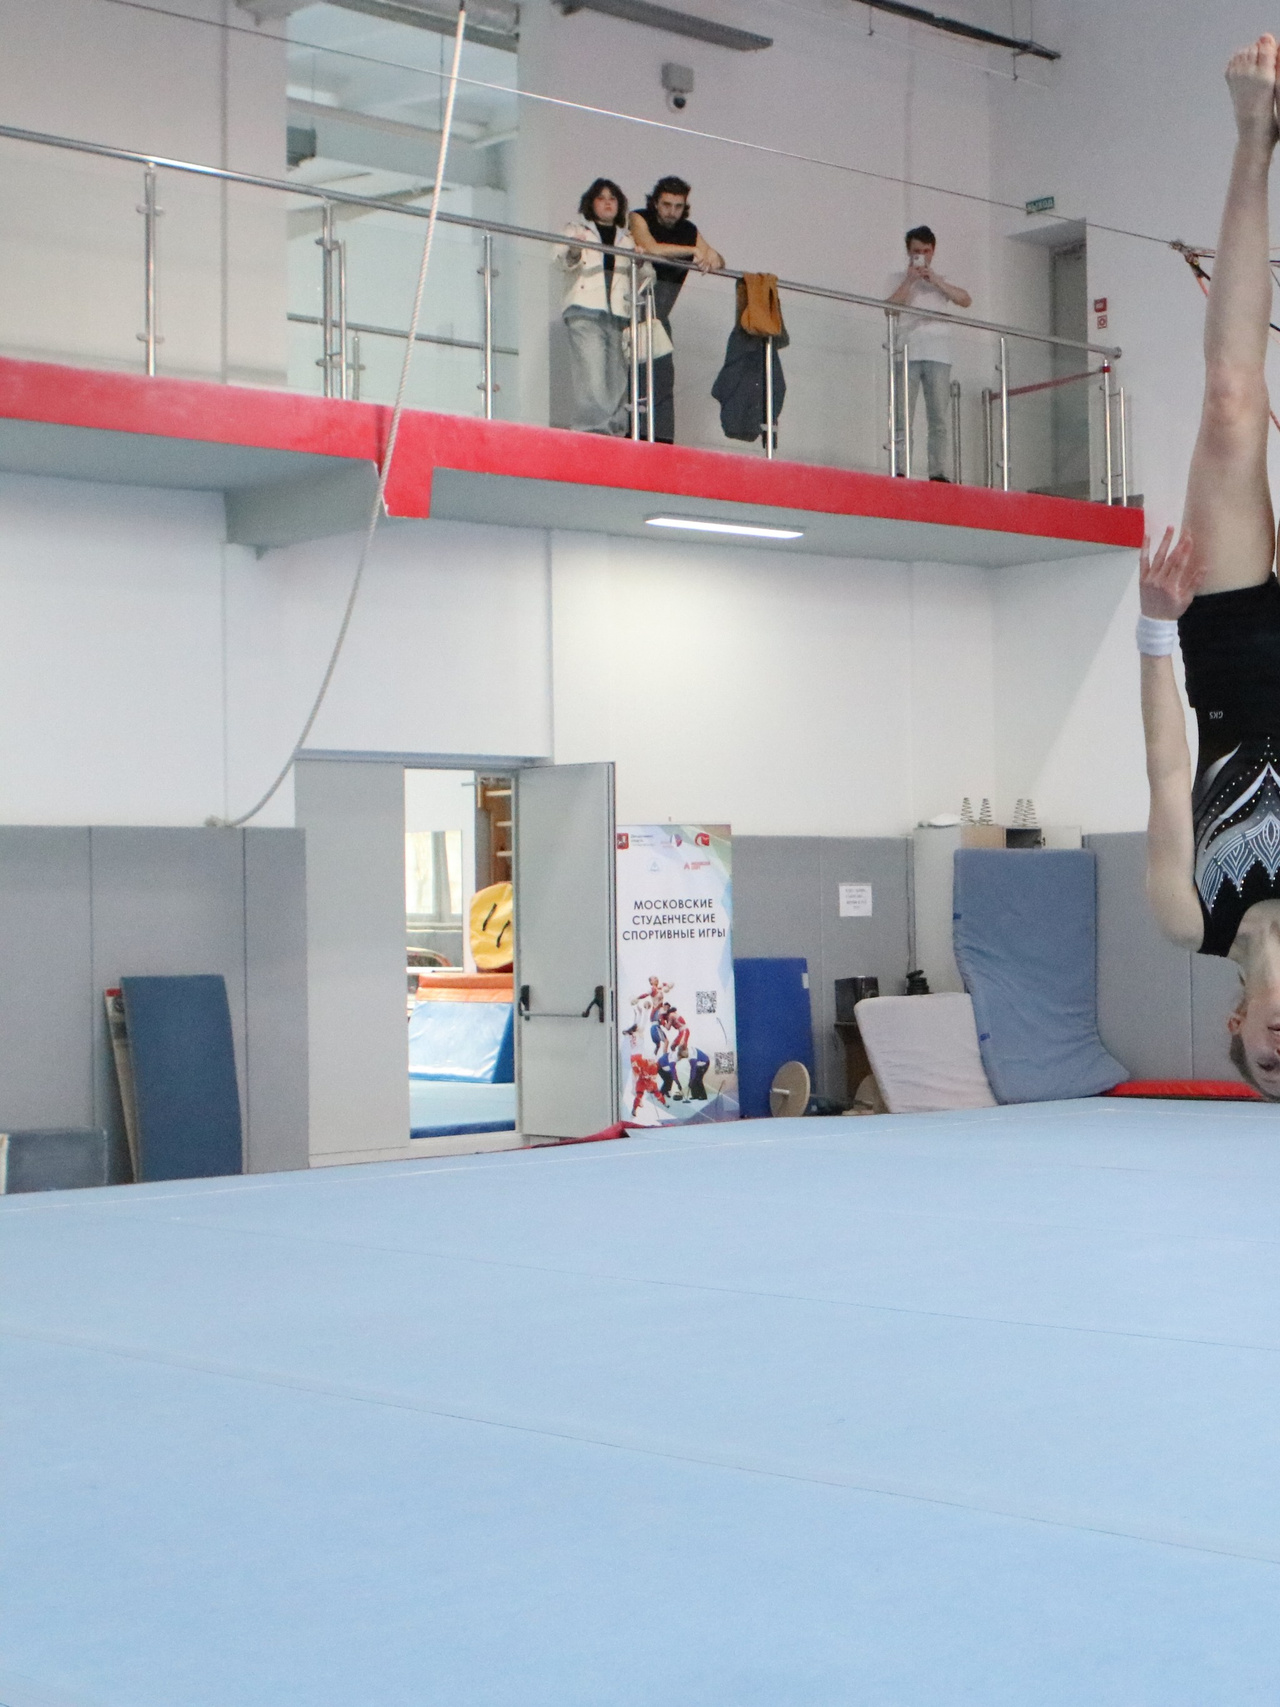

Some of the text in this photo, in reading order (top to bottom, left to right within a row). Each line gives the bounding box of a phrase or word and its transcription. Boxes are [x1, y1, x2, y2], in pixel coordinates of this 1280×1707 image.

[633, 898, 713, 910] МОСКОВСКИЕ
[632, 913, 715, 925] СТУДЕНЧЕСКИЕ
[622, 928, 726, 940] СПОРТИВНЫЕ ИГРЫ
